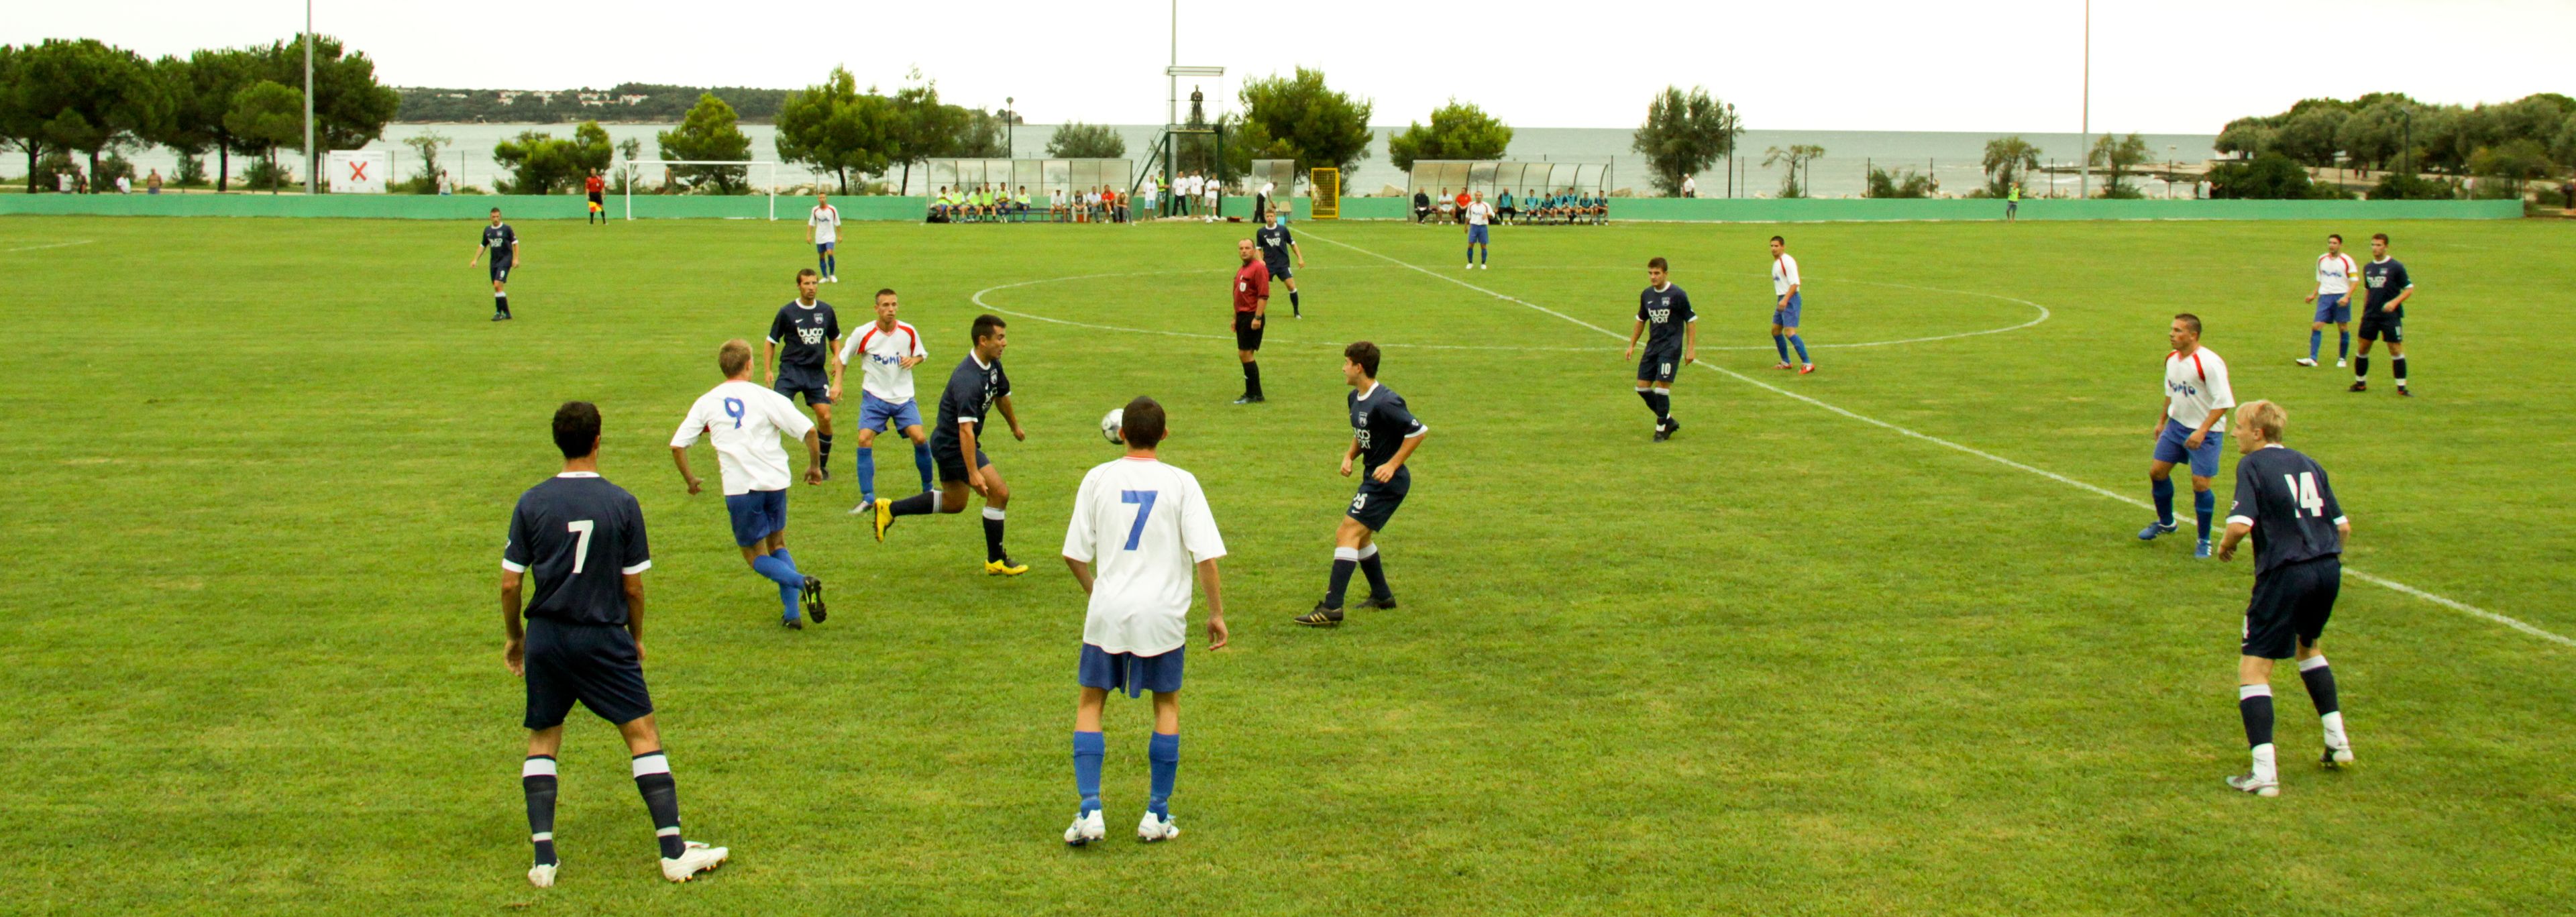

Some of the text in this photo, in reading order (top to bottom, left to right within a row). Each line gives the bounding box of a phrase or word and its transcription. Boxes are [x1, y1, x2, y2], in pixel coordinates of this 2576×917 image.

[1661, 362, 1671, 375] 10
[724, 397, 745, 429] 9
[2284, 472, 2324, 519] 14
[1121, 490, 1159, 551] 7
[568, 520, 594, 574] 7
